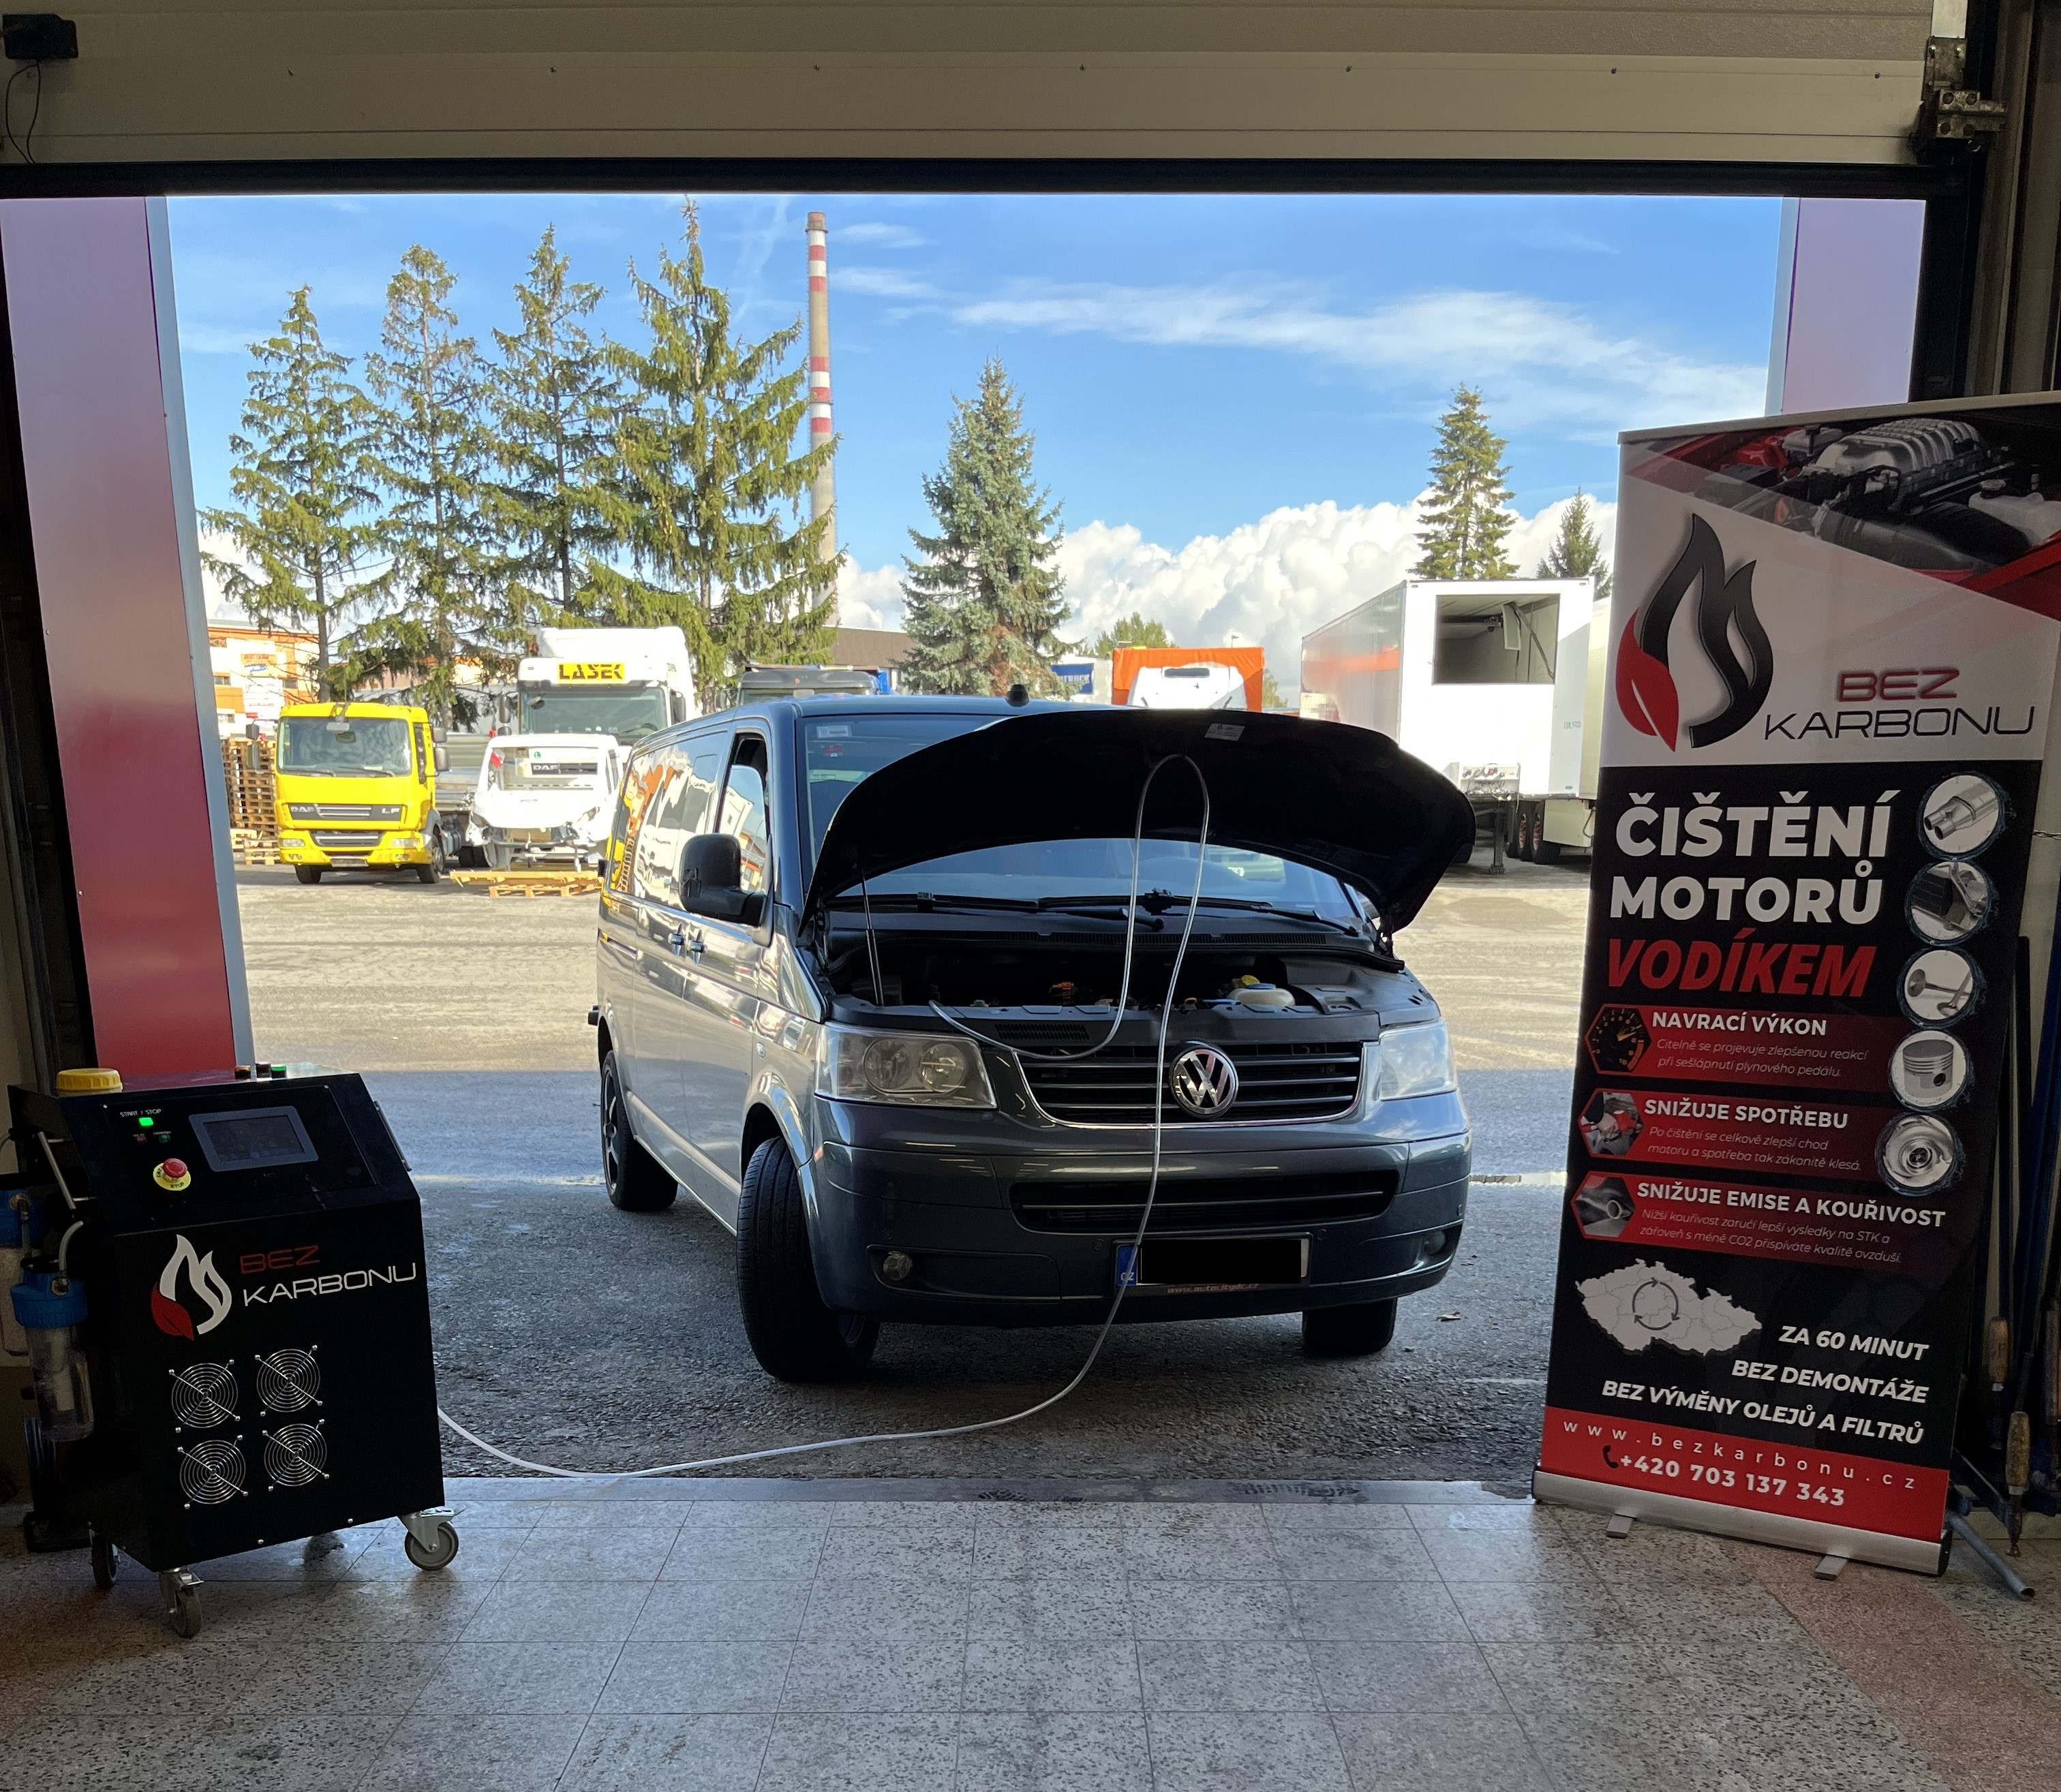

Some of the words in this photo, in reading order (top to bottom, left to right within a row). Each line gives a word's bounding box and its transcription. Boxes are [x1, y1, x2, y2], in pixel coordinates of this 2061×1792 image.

[1836, 668, 1960, 702] BEZ
[1765, 706, 2034, 740] KARBONU
[1615, 790, 1901, 858] ČIŠTĚNÍ
[1609, 860, 1883, 925] MOTORŮ
[1608, 927, 1878, 998] VODÍKEM
[1652, 1011, 1747, 1031] NAVRACÍ
[1752, 1013, 1827, 1036] VÝKON
[1658, 1056, 1673, 1068] při
[1675, 1057, 1735, 1070] sešlápnutí
[1735, 1061, 1795, 1074] plynového
[1698, 1042, 1711, 1051] se
[1713, 1042, 1765, 1055] projevuje
[1767, 1045, 1827, 1057] zlepšenou
[1830, 1049, 1869, 1060] reakcí
[1644, 1097, 1730, 1119] SNIŽUJE
[1735, 1105, 1848, 1129] SPOTŘEBU
[1649, 1126, 1664, 1137] Po
[1705, 1132, 1717, 1141] se
[1720, 1133, 1761, 1144] celkově
[1763, 1136, 1797, 1148] zlepší
[1798, 1139, 1829, 1150] chod
[1647, 1145, 1689, 1156] motoru
[1701, 1149, 1752, 1161] spotřeba
[1754, 1153, 1773, 1162] tak
[1775, 1154, 1826, 1168] zákonitě
[1636, 1181, 1722, 1204] SNIŽUJE
[1727, 1190, 1790, 1211] EMISE
[1794, 1198, 1811, 1214] A
[1816, 1199, 1946, 1227] KOUŘIVOST
[1670, 1211, 1719, 1226] kouřivost
[1758, 1220, 1785, 1233] lepší
[1786, 1224, 1837, 1239] výsledky
[1838, 1231, 1854, 1239] na
[1856, 1231, 1880, 1242] STK
[1881, 1235, 1890, 1243] a
[1685, 1231, 1692, 1239] s
[1728, 1235, 1753, 1246] CO2
[239, 1245, 320, 1274] BEZ
[243, 1262, 416, 1306] KARBONU
[1778, 1325, 1810, 1346] ZA
[1816, 1331, 1846, 1349] 60
[1849, 1334, 1930, 1361] MINUT
[1731, 1359, 1778, 1381] BEZ
[1780, 1366, 1929, 1404] DEMONTÁŽE
[1602, 1380, 1647, 1401] BEZ
[1649, 1386, 1741, 1415] VÝMĚNY
[1743, 1402, 1816, 1427] OLEJŮ
[1817, 1414, 1835, 1431] A
[1841, 1416, 1924, 1444] FILTRŮ
[1620, 1455, 1680, 1477] +420
[1690, 1464, 1735, 1487] 703
[1746, 1473, 1787, 1496] 137
[1796, 1483, 1845, 1506] 343
